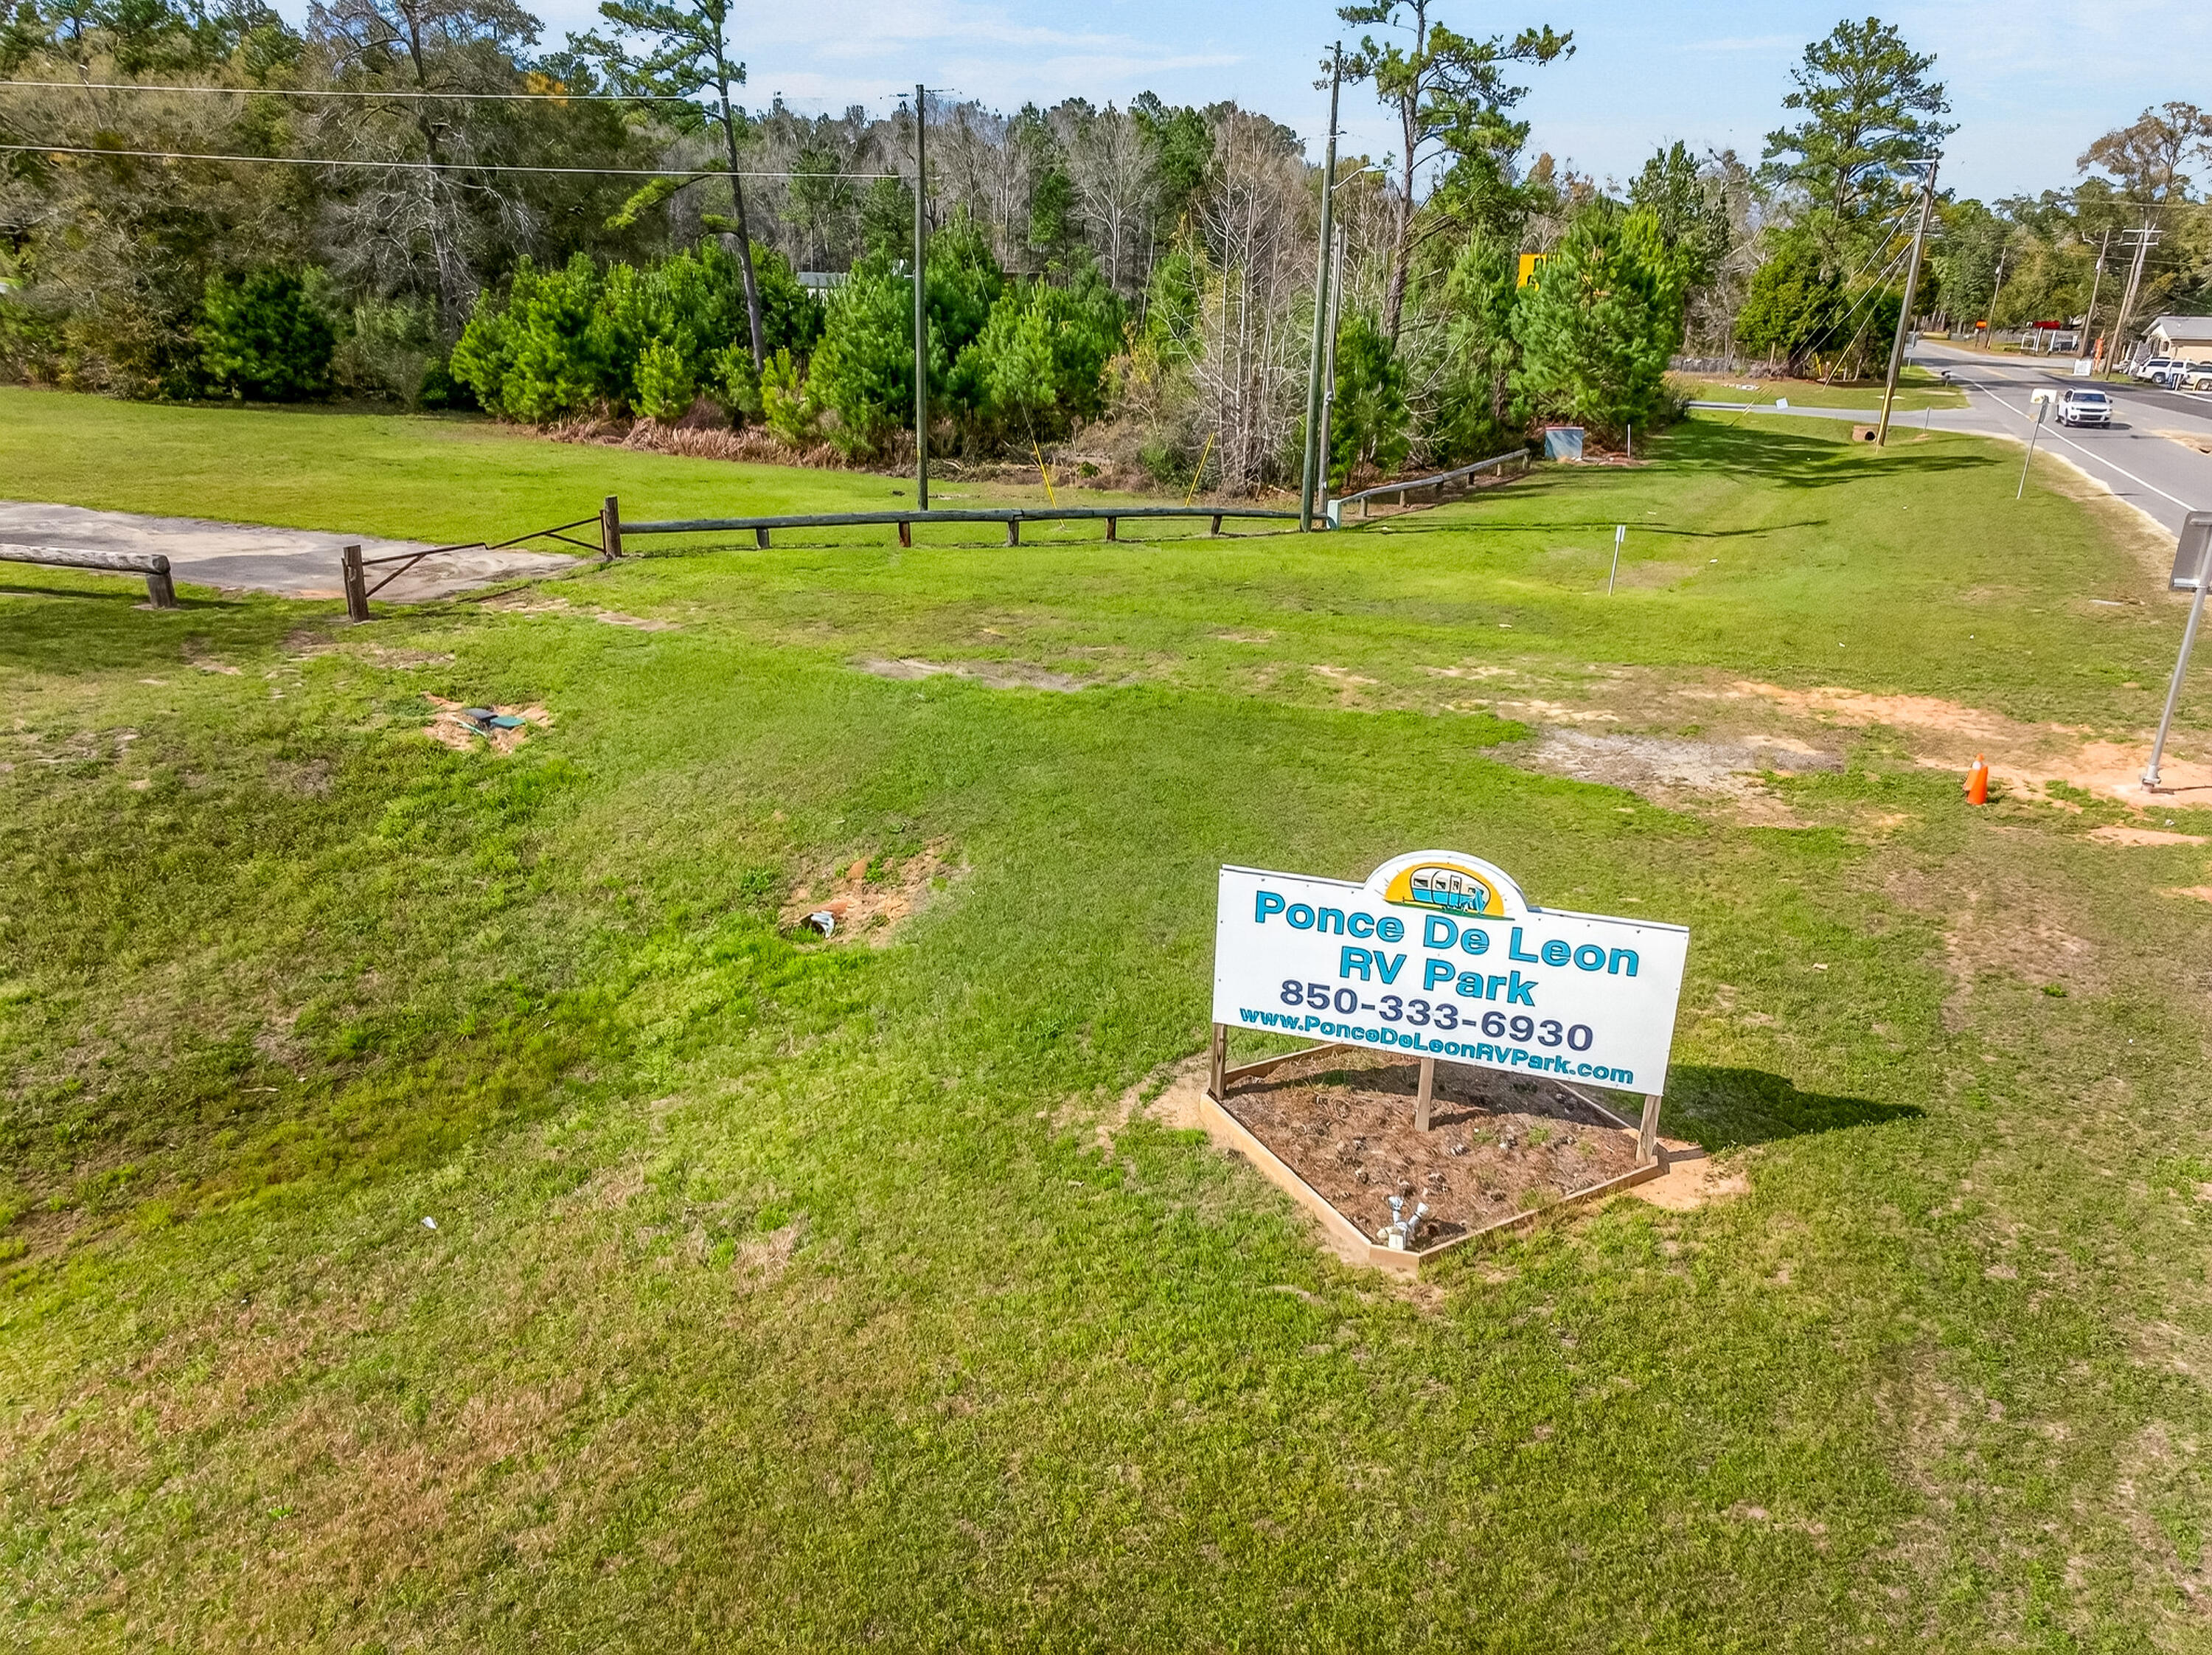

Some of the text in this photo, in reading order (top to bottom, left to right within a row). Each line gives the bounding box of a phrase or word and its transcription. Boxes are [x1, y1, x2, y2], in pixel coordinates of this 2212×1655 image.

[1255, 890, 1640, 976] Ponce De Leon
[1340, 946, 1539, 1007] RV Park
[1239, 1007, 1633, 1084] www.PonceDeLeonRVPark.com
[1280, 979, 1593, 1052] 850-333-6930
